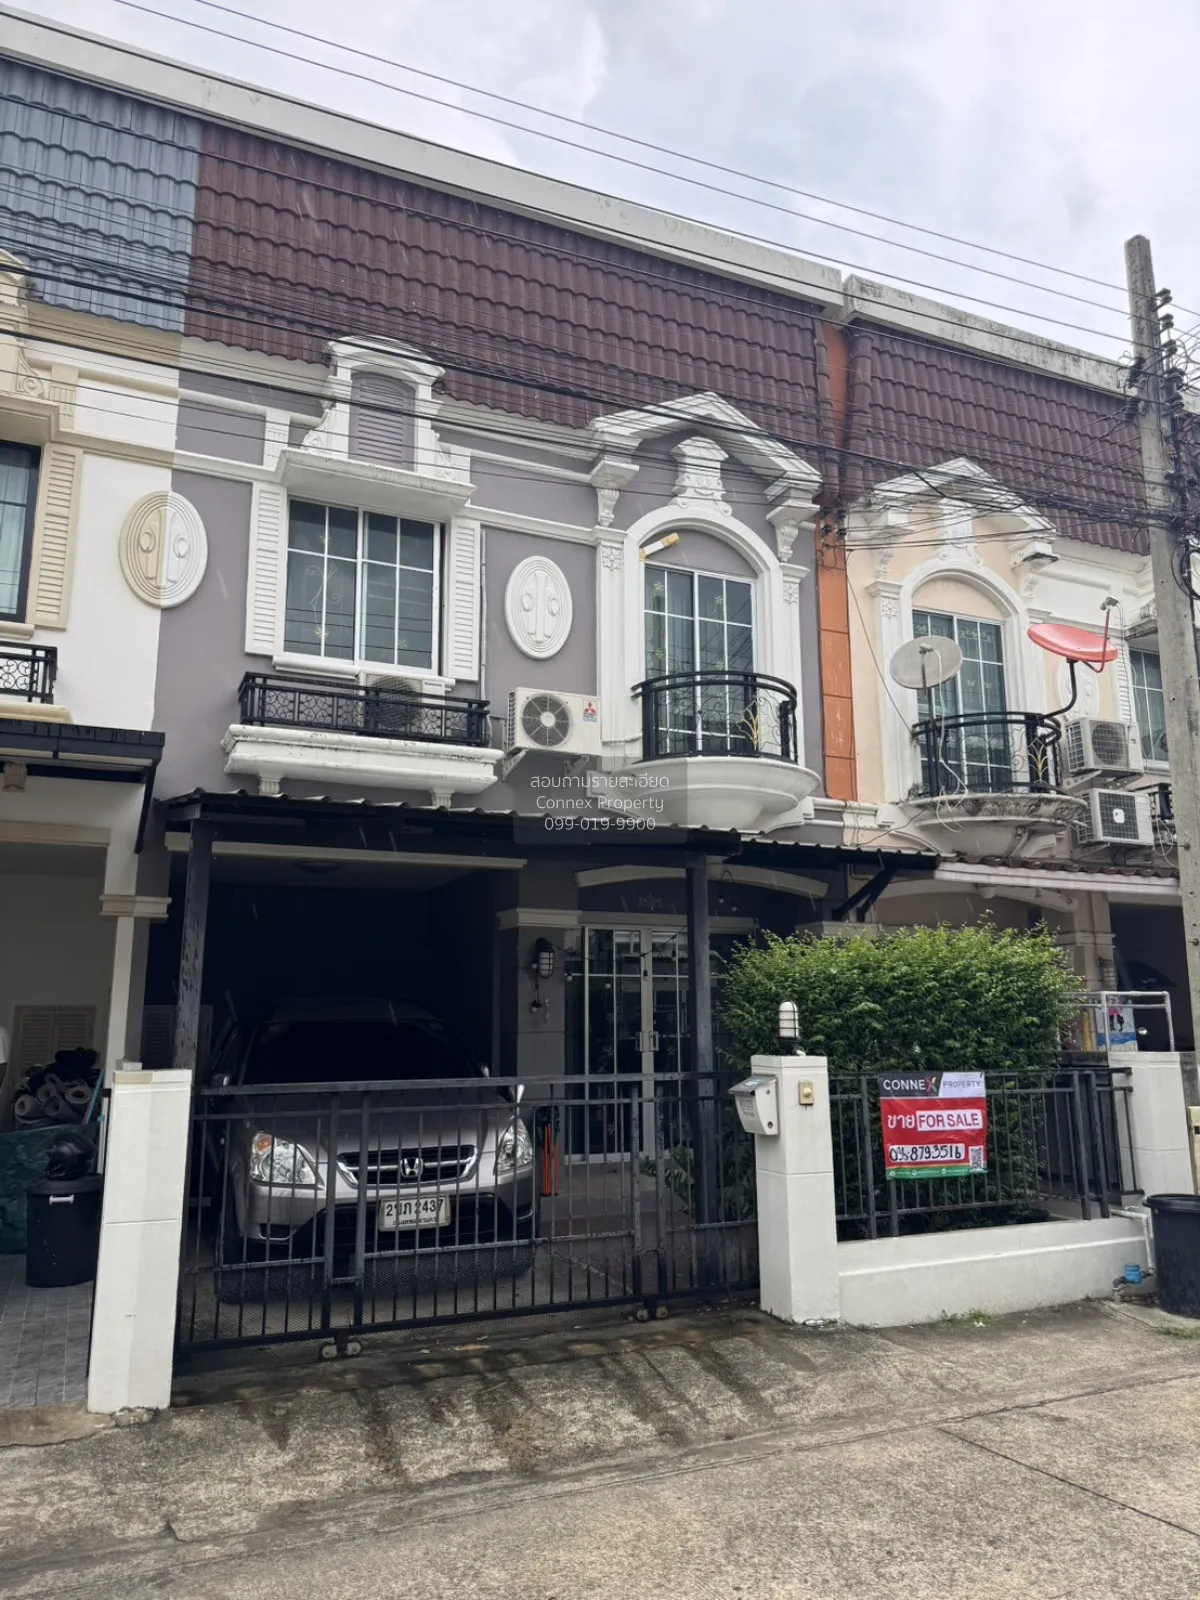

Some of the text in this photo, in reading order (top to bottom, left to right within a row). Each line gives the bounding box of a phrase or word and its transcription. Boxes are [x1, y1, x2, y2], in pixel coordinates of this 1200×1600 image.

[883, 1076, 981, 1093] CONNEX PROPERTY
[887, 1114, 916, 1129] ขาย
[918, 1113, 980, 1128] FOR SALE
[415, 1199, 444, 1214] 2437
